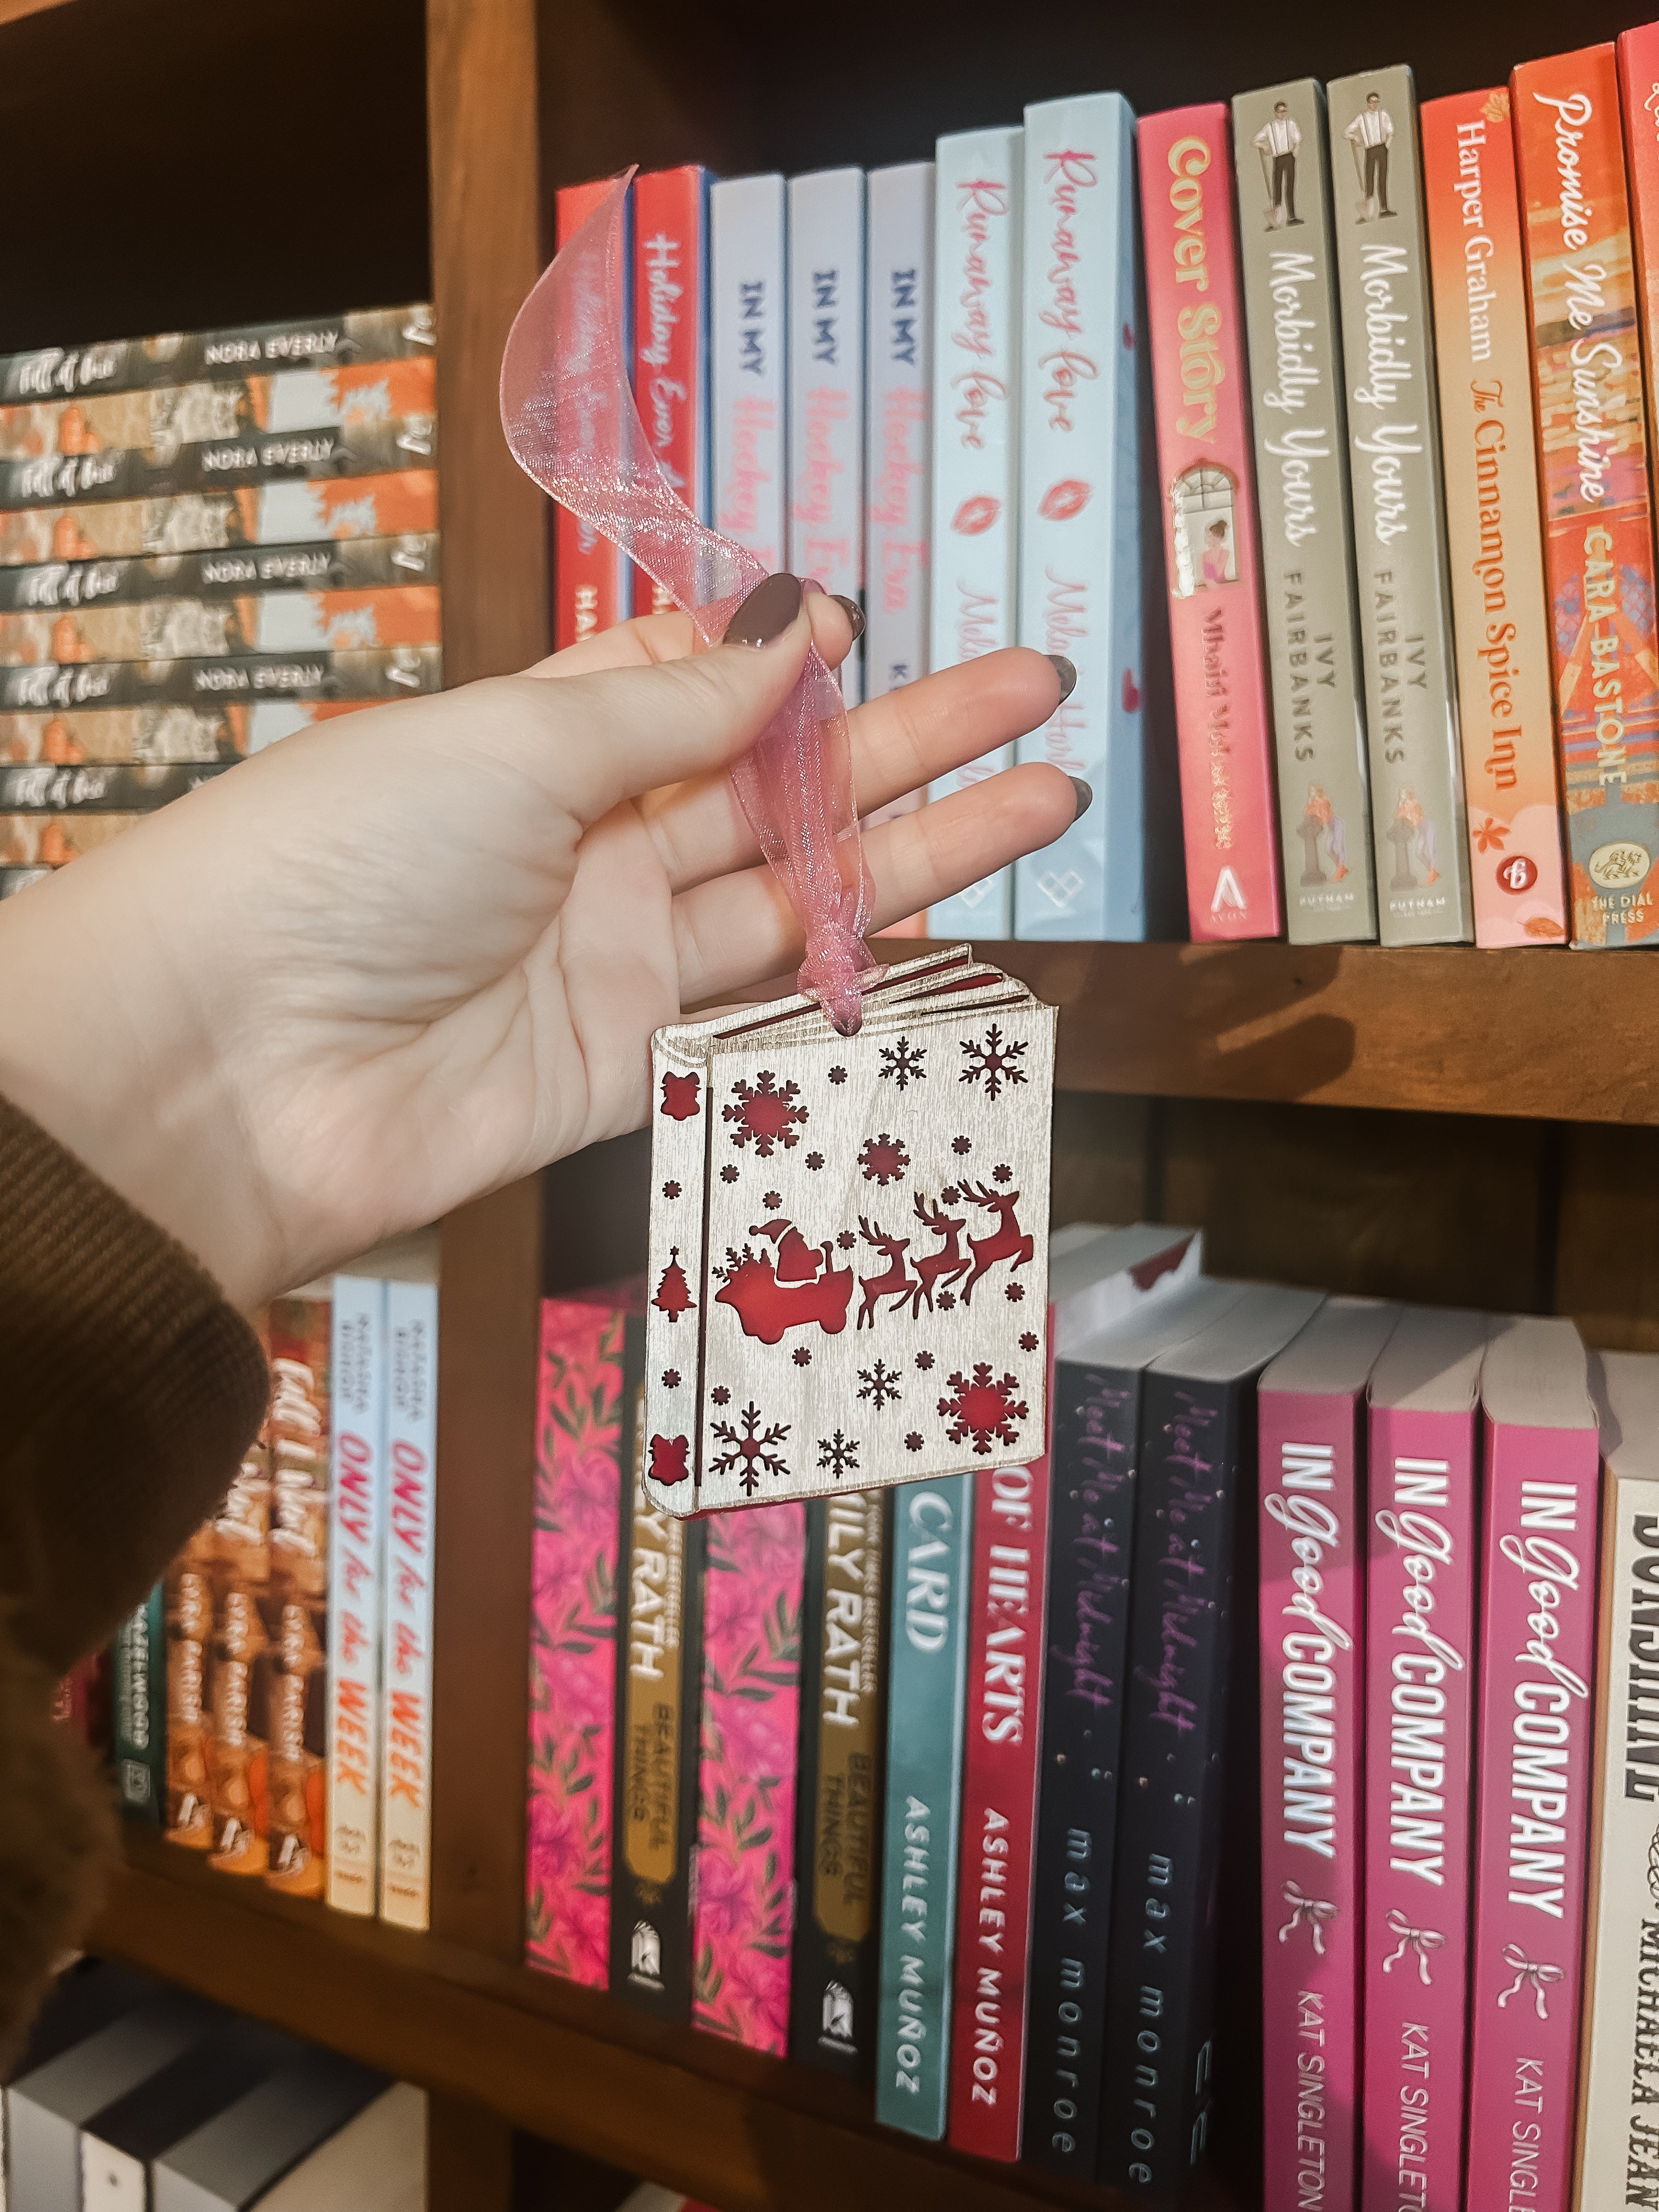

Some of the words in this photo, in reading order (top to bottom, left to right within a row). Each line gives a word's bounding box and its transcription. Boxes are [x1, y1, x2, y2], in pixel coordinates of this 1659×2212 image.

[1167, 137, 1210, 292] Cover
[1452, 119, 1486, 228] Harper
[1532, 91, 1593, 251] Promise
[640, 233, 682, 366] Holiday
[740, 281, 765, 319] IN
[812, 269, 838, 308] IN
[892, 269, 916, 308] IN
[951, 179, 1007, 359] Runaway
[1039, 151, 1096, 337] Runaway
[1463, 236, 1494, 362] Graham
[1562, 262, 1607, 330] Me
[740, 330, 765, 376] MY
[812, 317, 838, 366] MY
[893, 317, 916, 366] MY
[1176, 304, 1225, 443] Story
[1263, 251, 1321, 415] Morbidly
[1353, 242, 1412, 410] Morbidly
[794, 386, 848, 525] Hockey
[870, 386, 925, 525] Hockey
[1471, 379, 1502, 413] The
[1570, 337, 1624, 503] Sunshine
[1263, 429, 1331, 547] Yours
[1355, 425, 1422, 545] Yours
[1472, 420, 1506, 614] Cinnamon
[1583, 526, 1612, 622] CARA
[1283, 571, 1314, 762] FAIRBANKS
[1314, 633, 1336, 689] IVY
[1374, 570, 1404, 764] FAIRBANKS
[1404, 635, 1427, 690] IVY
[1477, 623, 1517, 719] Spice
[1591, 635, 1627, 787] BASTONE
[1491, 725, 1521, 792] Inn
[1592, 895, 1615, 910] THE
[1621, 892, 1652, 907] DIAL
[1602, 910, 1644, 926] PRESS
[336, 1431, 372, 1543] ONLY
[391, 1438, 426, 1554] ONLY
[991, 1465, 1032, 1531] OF
[1281, 1442, 1334, 1491] IN
[1393, 1457, 1449, 1507] IN
[1520, 1480, 1578, 1531] IN
[629, 1547, 668, 1681] RATH
[906, 1492, 953, 1651] CARD
[1264, 1492, 1352, 1651] Good
[1375, 1509, 1464, 1672] Good
[1499, 1534, 1589, 1699] Good
[822, 1589, 864, 1728] RATH
[982, 1544, 1030, 1743] HEARTS
[336, 1677, 368, 1796] WEEK
[389, 1690, 421, 1809] WEEK
[1282, 1631, 1336, 1859] COMPANY
[1390, 1652, 1446, 1886] COMPANY
[1508, 1680, 1570, 1918] COMPANY
[843, 1752, 873, 1905] BEAUTIFUL
[901, 1796, 931, 1943] ASHLEY
[979, 1807, 1009, 1954] ASHLEY
[1063, 1828, 1091, 1926] max
[1143, 1853, 1173, 1954] max
[1052, 1957, 1085, 2153] monroe
[1297, 1990, 1325, 2047] KAT
[1401, 2022, 1430, 2079] KAT
[1128, 1985, 1164, 2185] monroe
[1297, 2053, 1325, 2212] SINGLETON
[1514, 2057, 1544, 2114] KAT
